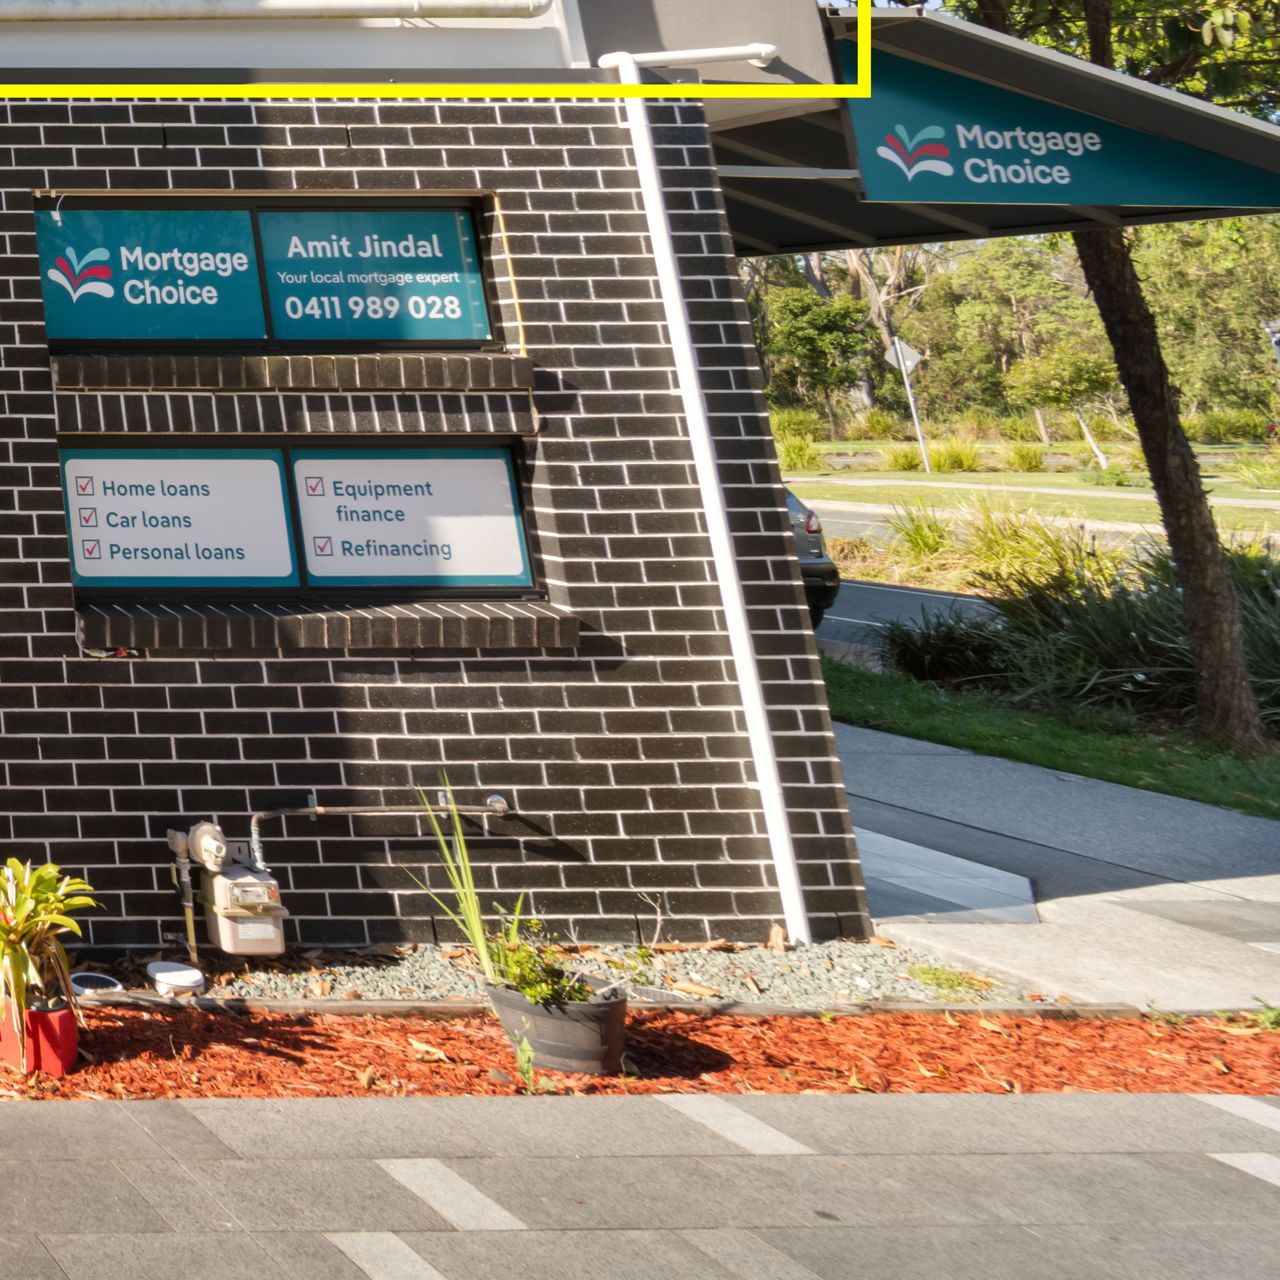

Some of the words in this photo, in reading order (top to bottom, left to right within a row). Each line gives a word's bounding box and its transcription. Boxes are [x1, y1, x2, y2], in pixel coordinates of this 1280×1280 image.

[956, 124, 1101, 156] Mortgage
[964, 158, 1071, 184] Choice
[288, 235, 352, 258] Amit
[358, 234, 443, 258] Jindal
[120, 247, 249, 277] Mortgage
[277, 272, 307, 284] Your
[310, 271, 344, 283] local
[348, 272, 413, 286] mortgage
[416, 272, 460, 286] expert
[124, 280, 218, 304] Choice
[285, 296, 341, 319] 0411
[348, 296, 400, 319] 989
[408, 296, 462, 319] 028
[102, 480, 156, 497] Home
[160, 480, 211, 497] loans
[333, 480, 433, 500] Equipment
[105, 511, 137, 528] Car
[142, 511, 192, 528] loans
[336, 505, 405, 522] finance
[109, 543, 191, 560] Personal
[195, 543, 245, 560] loans
[341, 539, 452, 560] Refinancing
